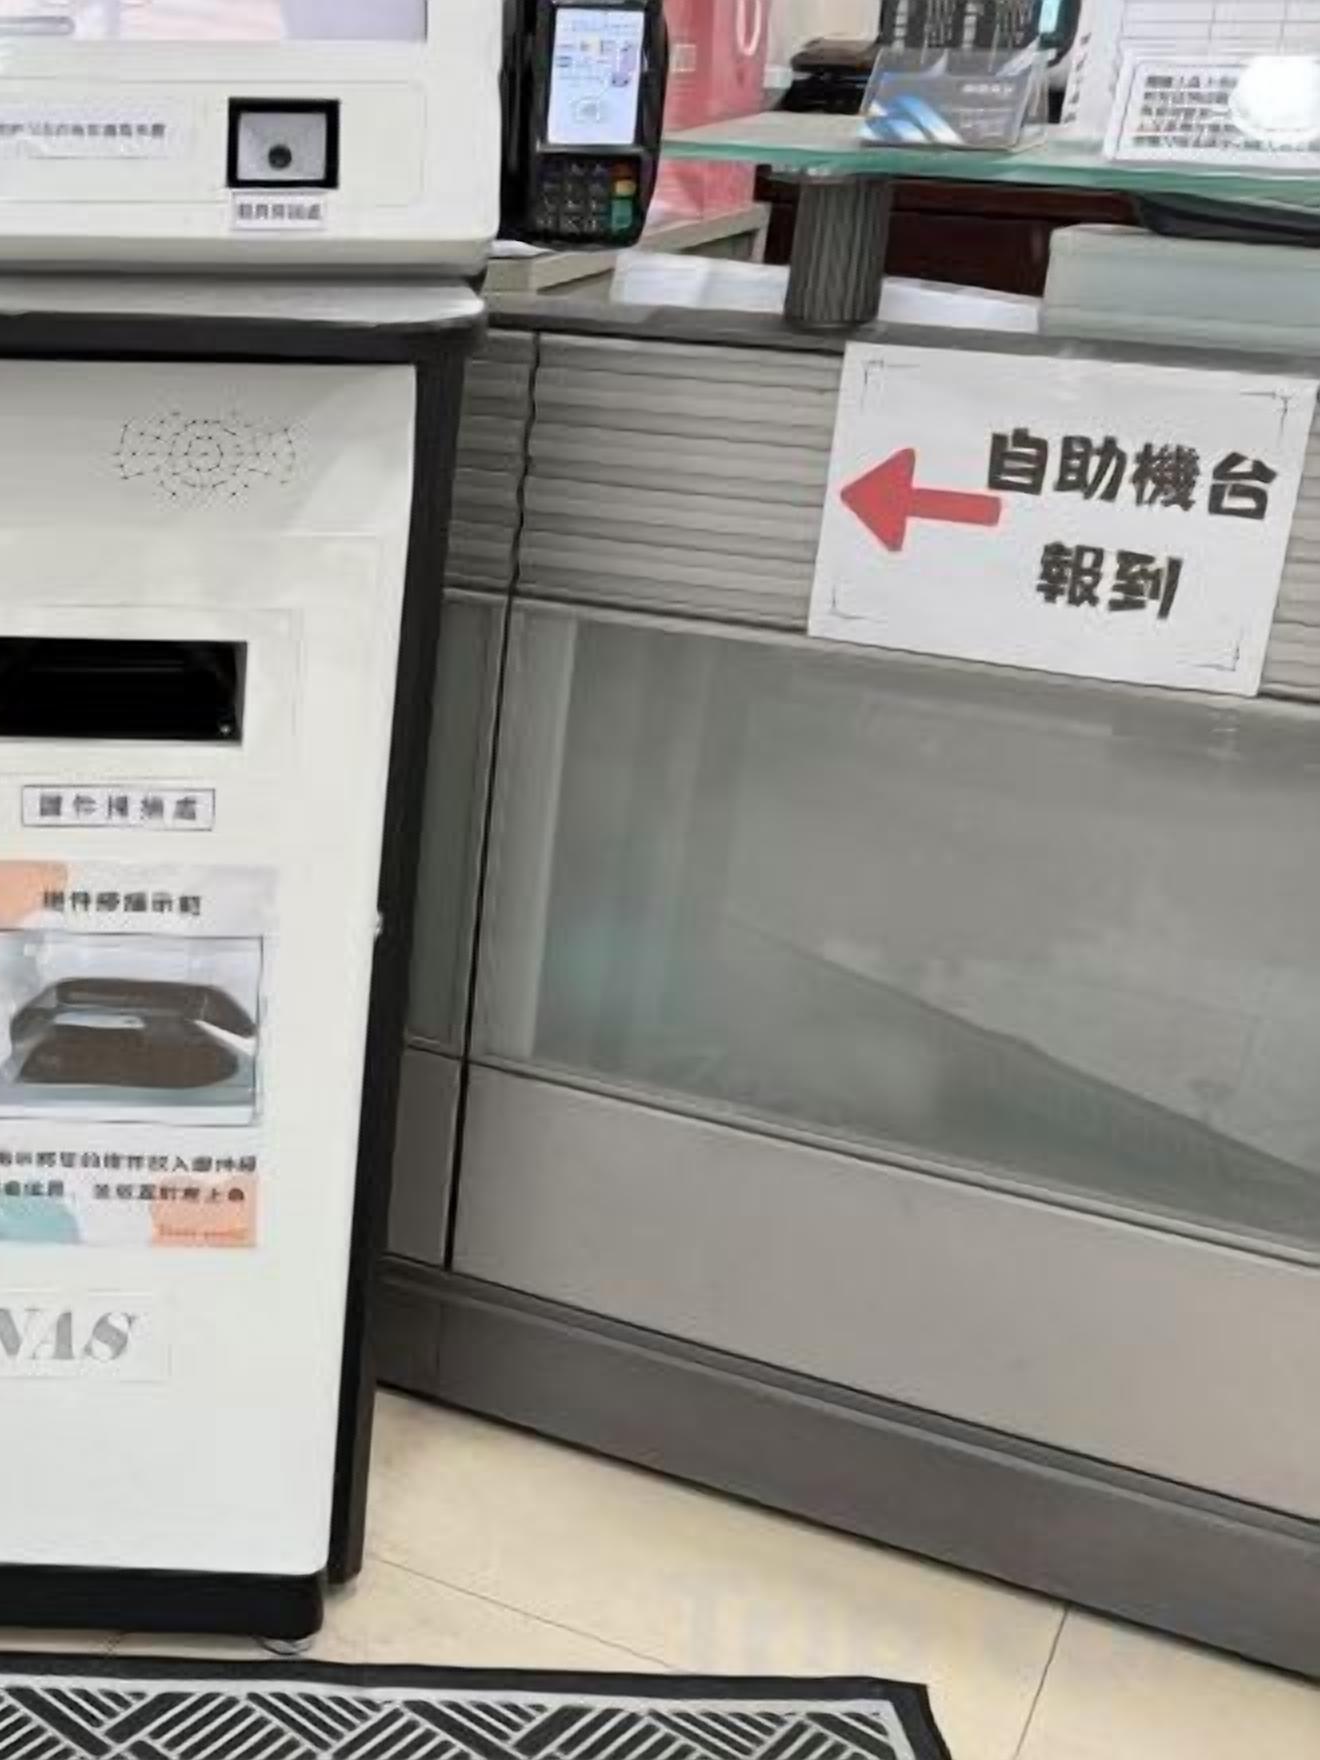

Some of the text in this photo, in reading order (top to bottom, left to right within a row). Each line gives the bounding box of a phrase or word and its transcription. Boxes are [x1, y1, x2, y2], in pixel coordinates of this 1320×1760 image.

[987, 427, 1278, 521] 自助機台
[1035, 541, 1184, 619] 報到
